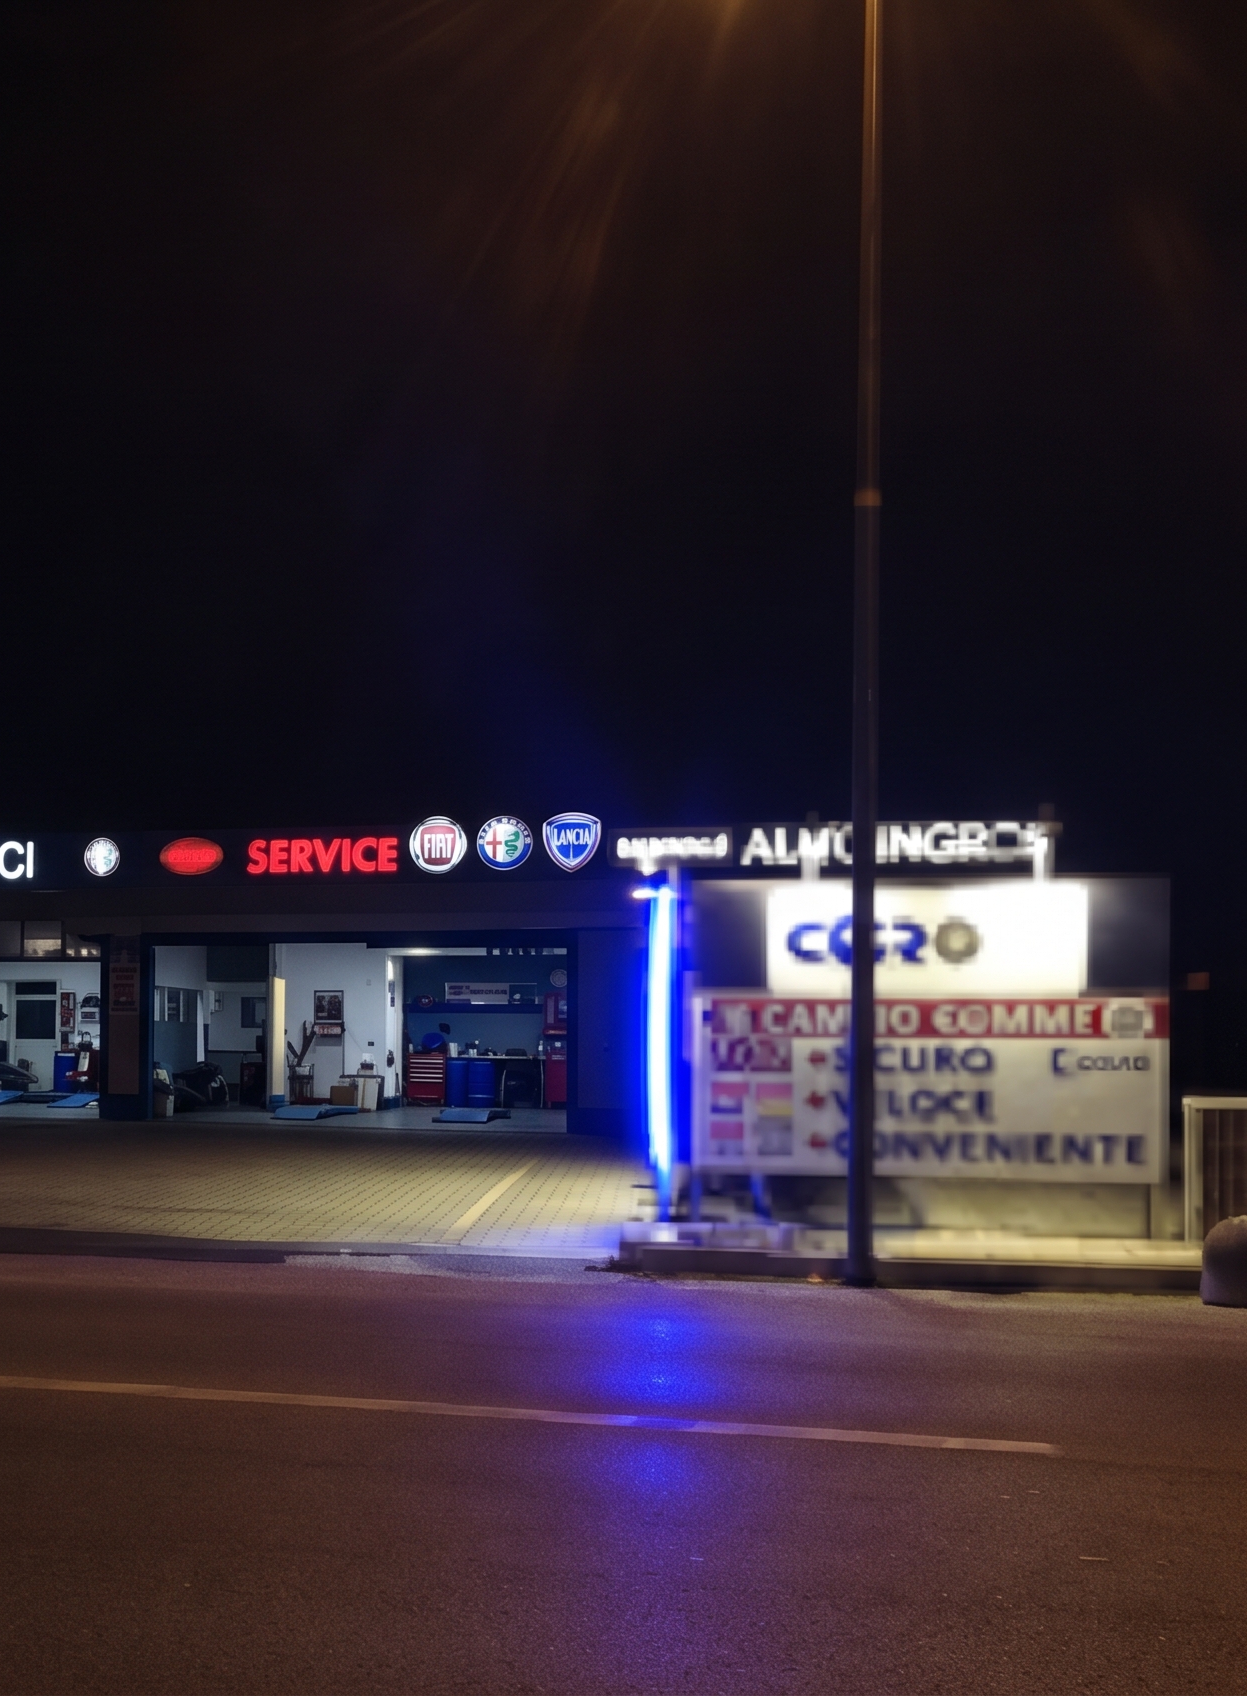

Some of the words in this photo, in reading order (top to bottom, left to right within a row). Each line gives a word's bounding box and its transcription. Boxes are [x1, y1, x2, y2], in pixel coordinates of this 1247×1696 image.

[423, 833, 454, 859] FIAT
[553, 827, 591, 846] LANCIA
[246, 836, 398, 874] SERVICE
[763, 1003, 921, 1034] CAMIO
[833, 1045, 996, 1074] SCURO
[830, 1089, 995, 1123] VLOCE
